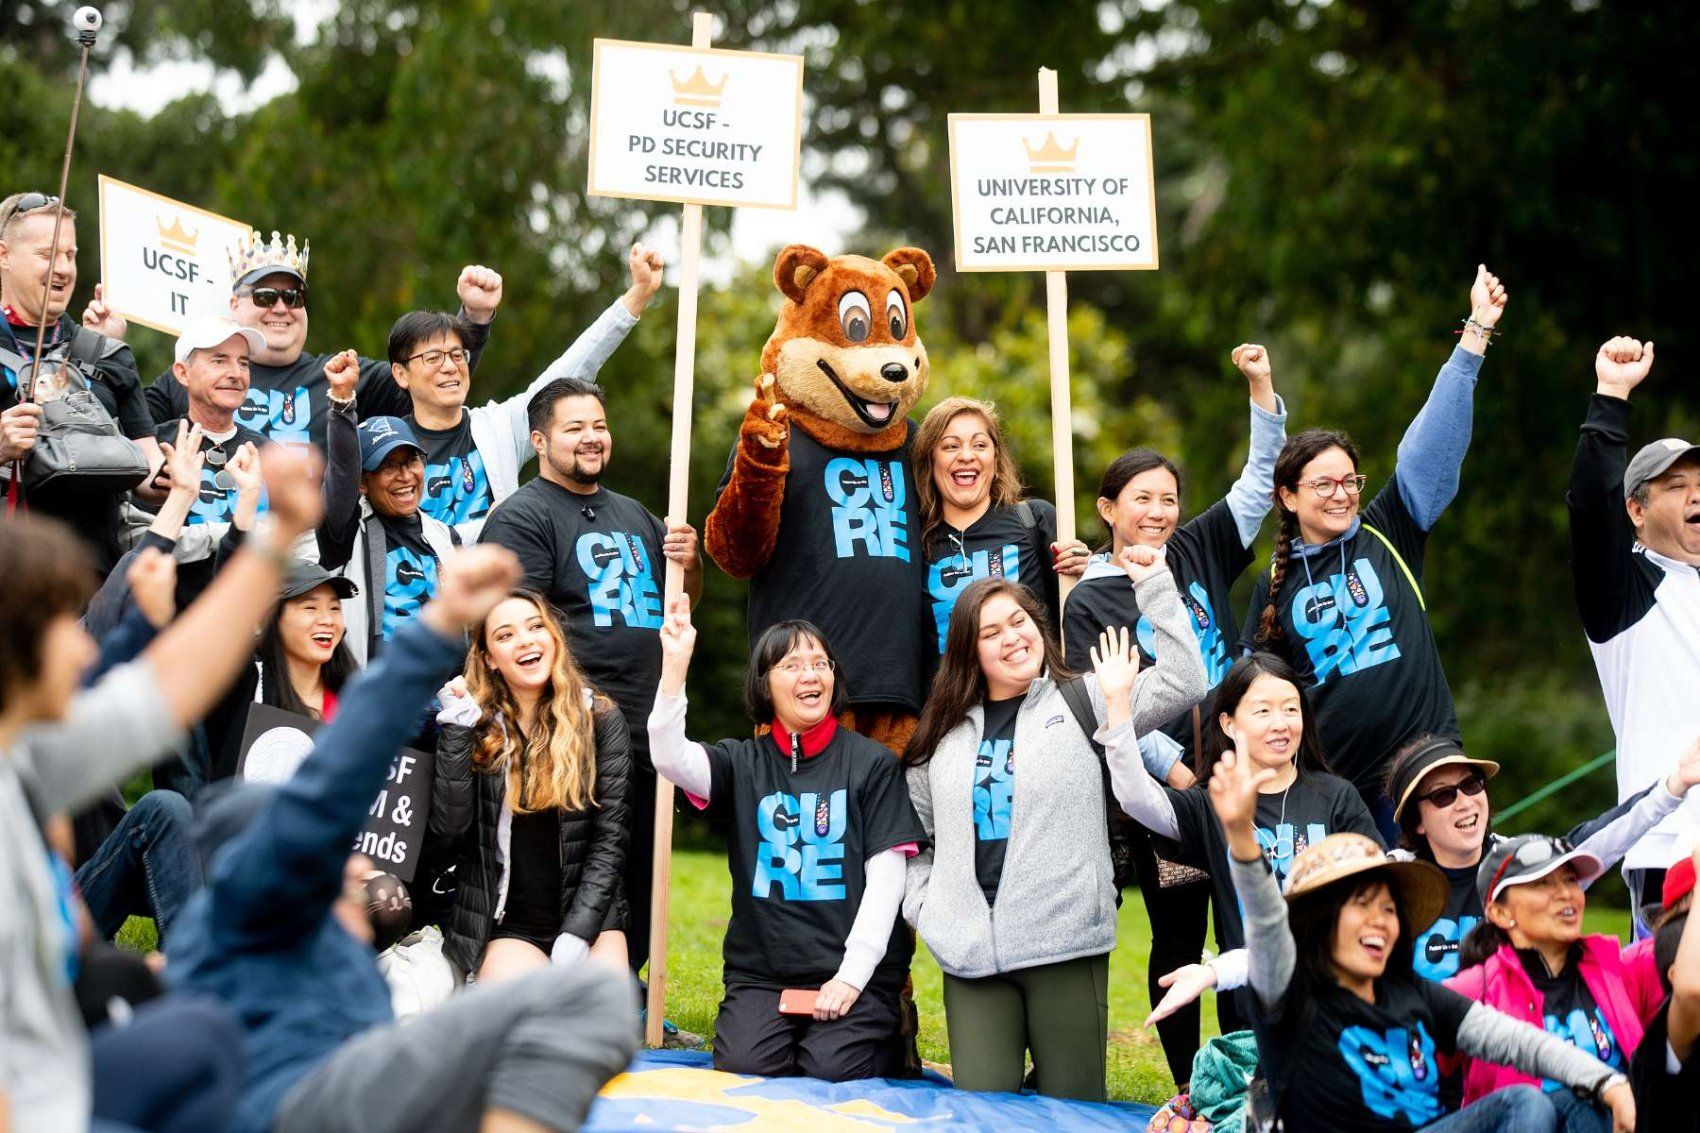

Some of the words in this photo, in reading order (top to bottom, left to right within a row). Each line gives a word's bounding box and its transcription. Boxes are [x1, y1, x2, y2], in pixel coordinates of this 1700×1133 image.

[663, 109, 716, 130] UCSF
[629, 135, 656, 153] PD
[662, 138, 763, 162] SECURITY
[645, 164, 744, 190] SERVICES
[977, 178, 1096, 197] UNIVERSITY
[1102, 178, 1129, 196] OF
[990, 207, 1120, 227] CALIFORNIA,
[973, 236, 1016, 254] SAN
[1022, 234, 1140, 253] FRANCISCO
[143, 247, 199, 283] UCSF
[171, 291, 189, 316] IT
[824, 457, 906, 510] CU
[831, 506, 911, 563] RE
[576, 531, 653, 581] CU
[588, 576, 664, 630] RE
[1292, 558, 1384, 639] CU
[1305, 606, 1401, 687] RE
[391, 795, 413, 827] &
[757, 789, 847, 846] CU
[752, 842, 847, 901] RE
